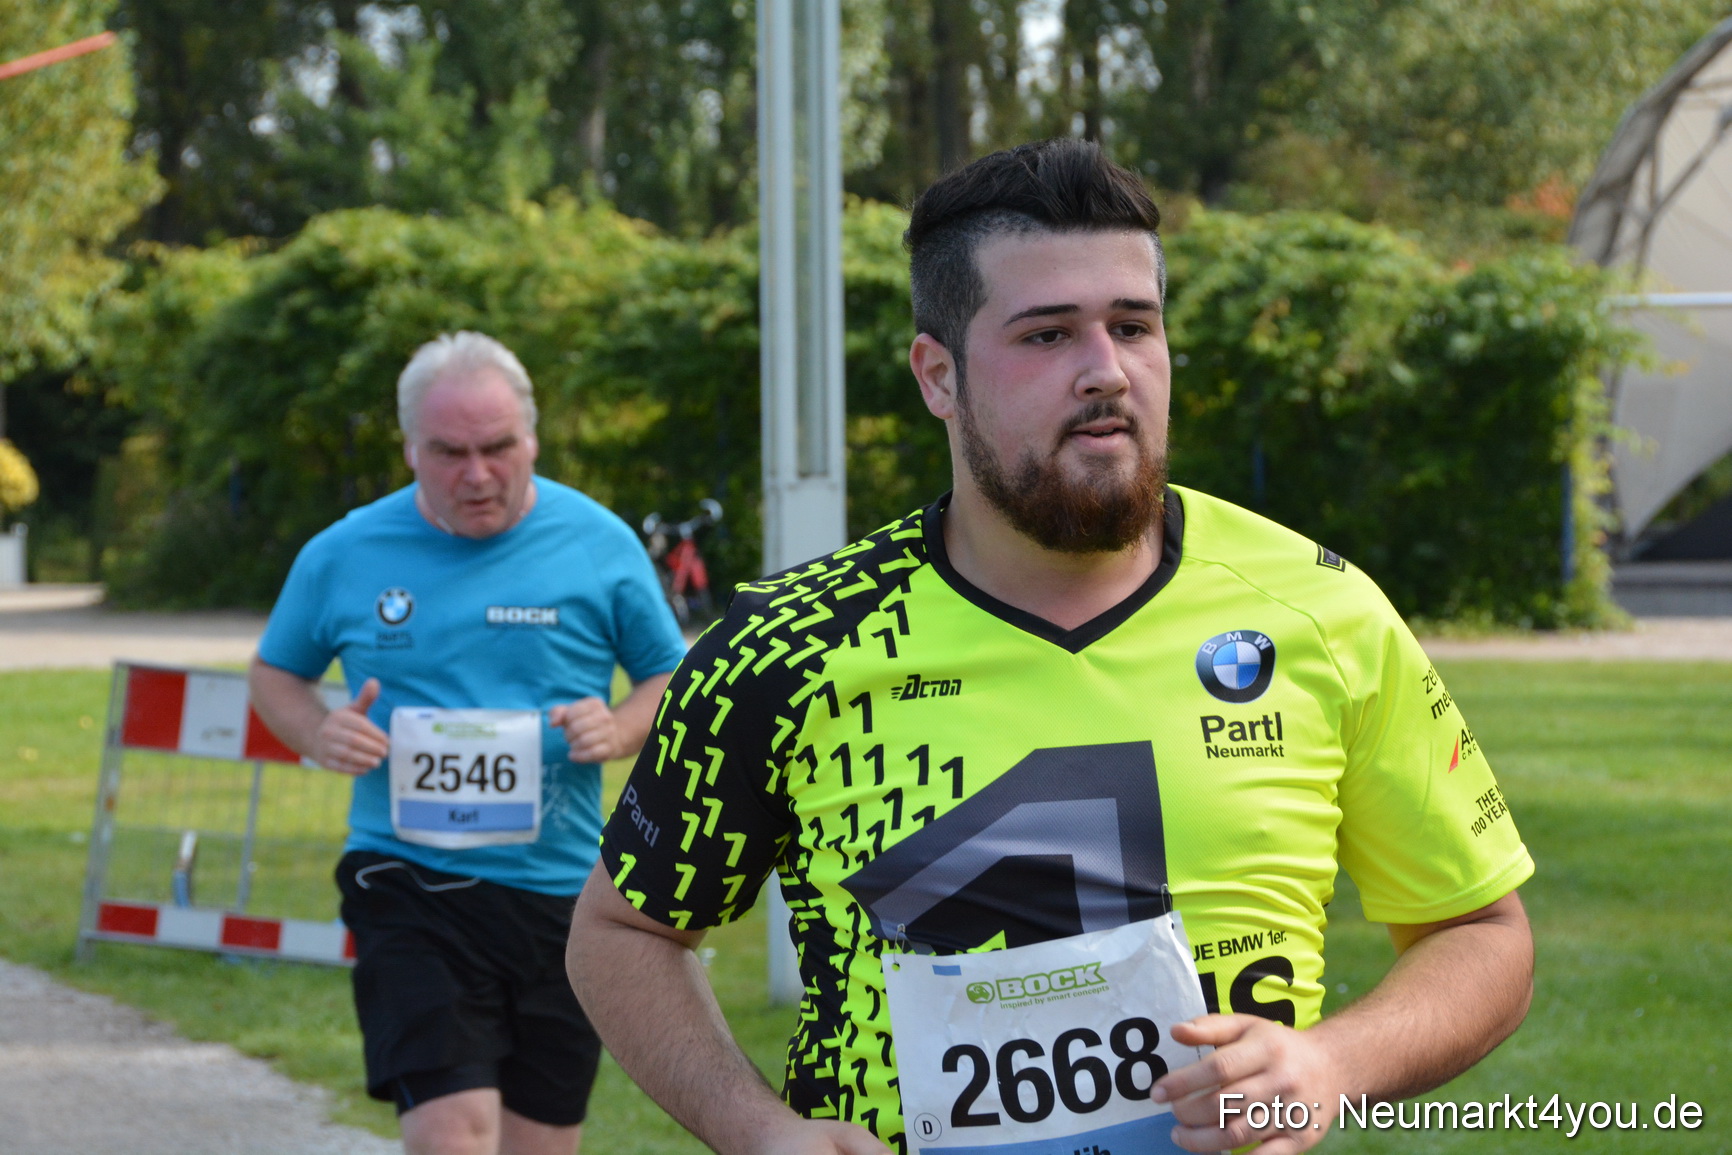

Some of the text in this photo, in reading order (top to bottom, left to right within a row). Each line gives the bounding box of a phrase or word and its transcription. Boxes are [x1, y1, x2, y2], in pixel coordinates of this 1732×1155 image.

[487, 606, 559, 625] BOCK
[1202, 631, 1272, 655] BMW
[1200, 712, 1283, 743] Partl
[1206, 743, 1285, 759] Neumarkt
[413, 752, 517, 793] 2546
[1476, 788, 1498, 811] THE
[622, 783, 660, 848] Partl
[1471, 801, 1508, 837] 100 YEA
[1218, 933, 1263, 957] BMW
[996, 961, 1107, 1001] BOCK
[1034, 997, 1045, 1005] by
[1047, 991, 1071, 1002] smart
[1072, 984, 1110, 997] concepts
[942, 1017, 1169, 1128] 2668
